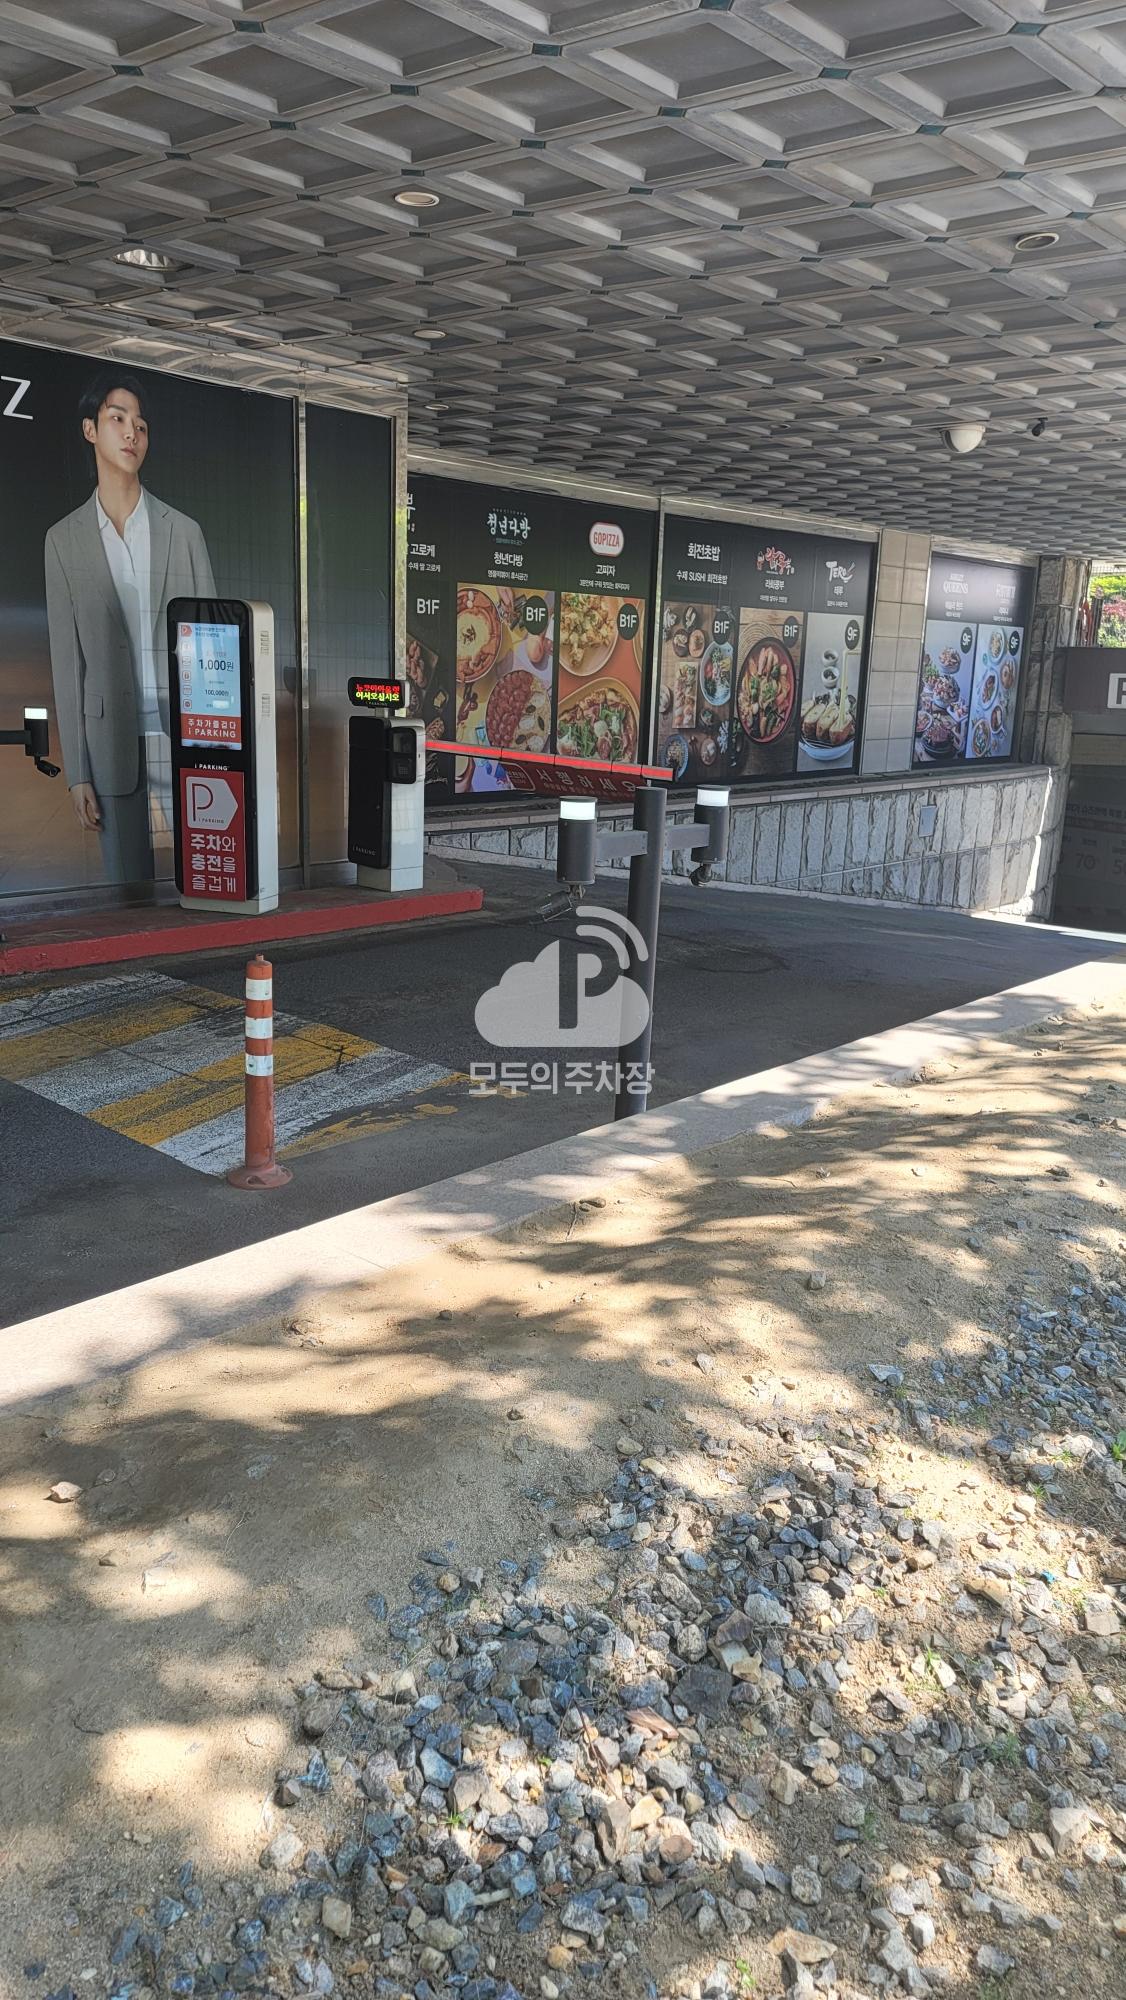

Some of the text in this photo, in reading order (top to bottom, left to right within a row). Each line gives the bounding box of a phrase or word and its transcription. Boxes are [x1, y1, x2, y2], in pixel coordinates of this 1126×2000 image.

[1, 376, 34, 420] Z
[487, 512, 531, 539] 청년다방
[594, 531, 620, 547] GOPIZZA
[410, 544, 435, 557] 고로케
[687, 542, 720, 562] 회전초밥
[494, 552, 523, 566] 청년다방
[595, 564, 616, 577] 고피자
[676, 571, 728, 585] 수제 SUSHI 회전초밥
[417, 598, 440, 615] B1F
[526, 606, 546, 622] B1F
[619, 613, 638, 629] B1F
[714, 620, 730, 634] B1F
[784, 624, 798, 638] B1F
[847, 624, 858, 638] 9F
[962, 632, 971, 646] 9F
[1010, 634, 1018, 649] 9F
[198, 658, 234, 672] 1,000원
[355, 691, 400, 701] 어서오십시오
[195, 728, 236, 738] PARKING
[199, 763, 228, 771] PARKING
[191, 834, 236, 852] 주차와
[191, 853, 236, 873] 충전을
[191, 874, 237, 893] 즐겁게
